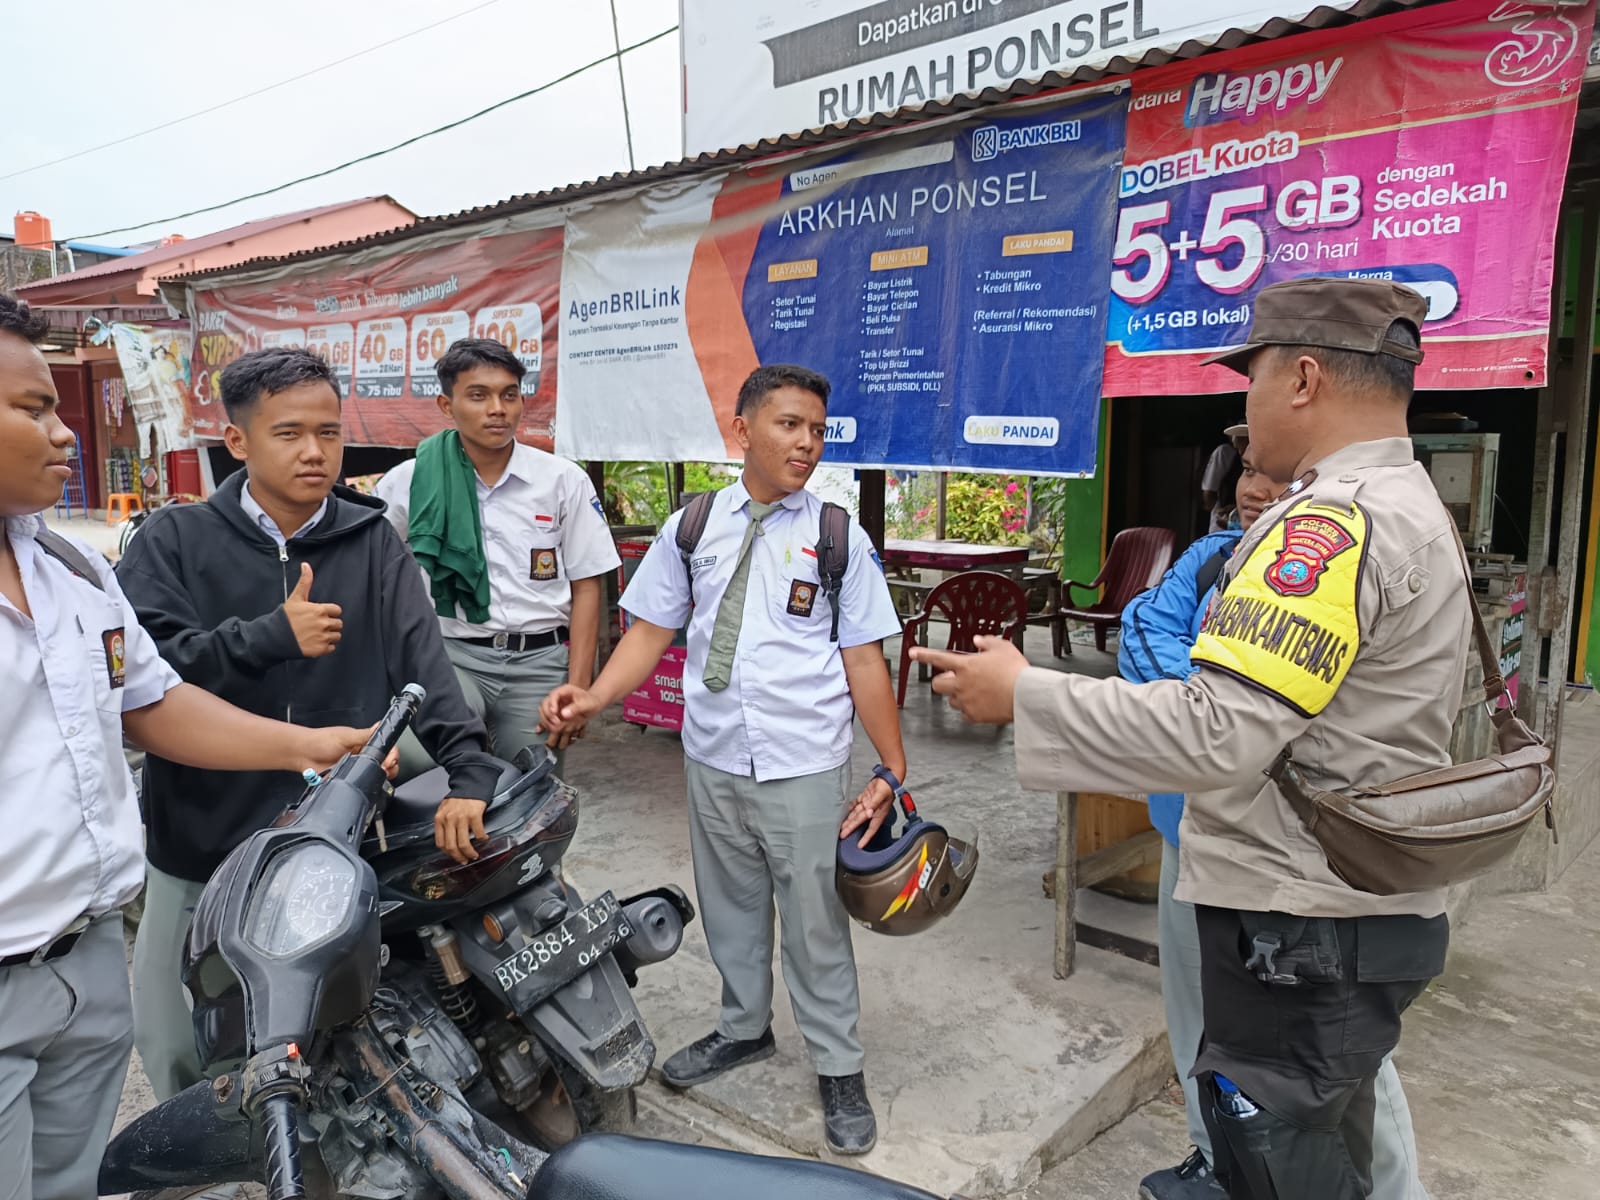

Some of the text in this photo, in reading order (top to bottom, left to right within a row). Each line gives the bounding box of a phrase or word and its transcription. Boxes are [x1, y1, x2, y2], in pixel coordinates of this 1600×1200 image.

[858, 0, 957, 46] Dapatkan
[818, 0, 1160, 125] RUMAH PONSEL
[1188, 57, 1344, 119] Happy
[999, 120, 1081, 150] BANK BRI
[1121, 135, 1294, 194] DOBEL Kuota
[796, 170, 838, 186] No Agen
[1376, 162, 1455, 184] dengan
[1373, 176, 1507, 212] Sedekah
[778, 170, 1047, 236] ARKHAN PONSEL
[1276, 175, 1360, 230] GB
[1372, 213, 1461, 240] Kuota
[1010, 238, 1065, 249] LAKU PANDAI
[1271, 238, 1360, 263] /30 hari
[878, 252, 921, 265] MINI ATM
[774, 264, 813, 277] LAYANAN
[983, 269, 1032, 281] Tabungan
[867, 277, 912, 291] Bayar Listrik
[982, 280, 1042, 294] Kredit Mikro
[569, 285, 681, 322] AgenBRILink
[795, 293, 816, 304] Tunai
[867, 290, 919, 303] Bayar Telepon
[794, 305, 814, 316] Tunai
[867, 301, 917, 314] Bayar Cicilan
[973, 309, 1015, 322] (Referral
[1022, 305, 1097, 318] Rekomendasi)
[866, 315, 880, 325] Beli
[1167, 310, 1197, 328] GB
[1202, 304, 1250, 326] lokal)
[866, 326, 895, 336] Transfer
[979, 320, 1054, 333] Asuransi Mikro
[360, 332, 404, 363] 40 GB
[416, 327, 446, 361] 60
[520, 340, 538, 353] GB
[902, 346, 924, 356] Tunai
[864, 361, 877, 371] Top
[878, 360, 888, 370] Up
[863, 372, 891, 382] Program
[368, 385, 380, 396] 75
[967, 423, 1054, 440] LAKU PANDAI
